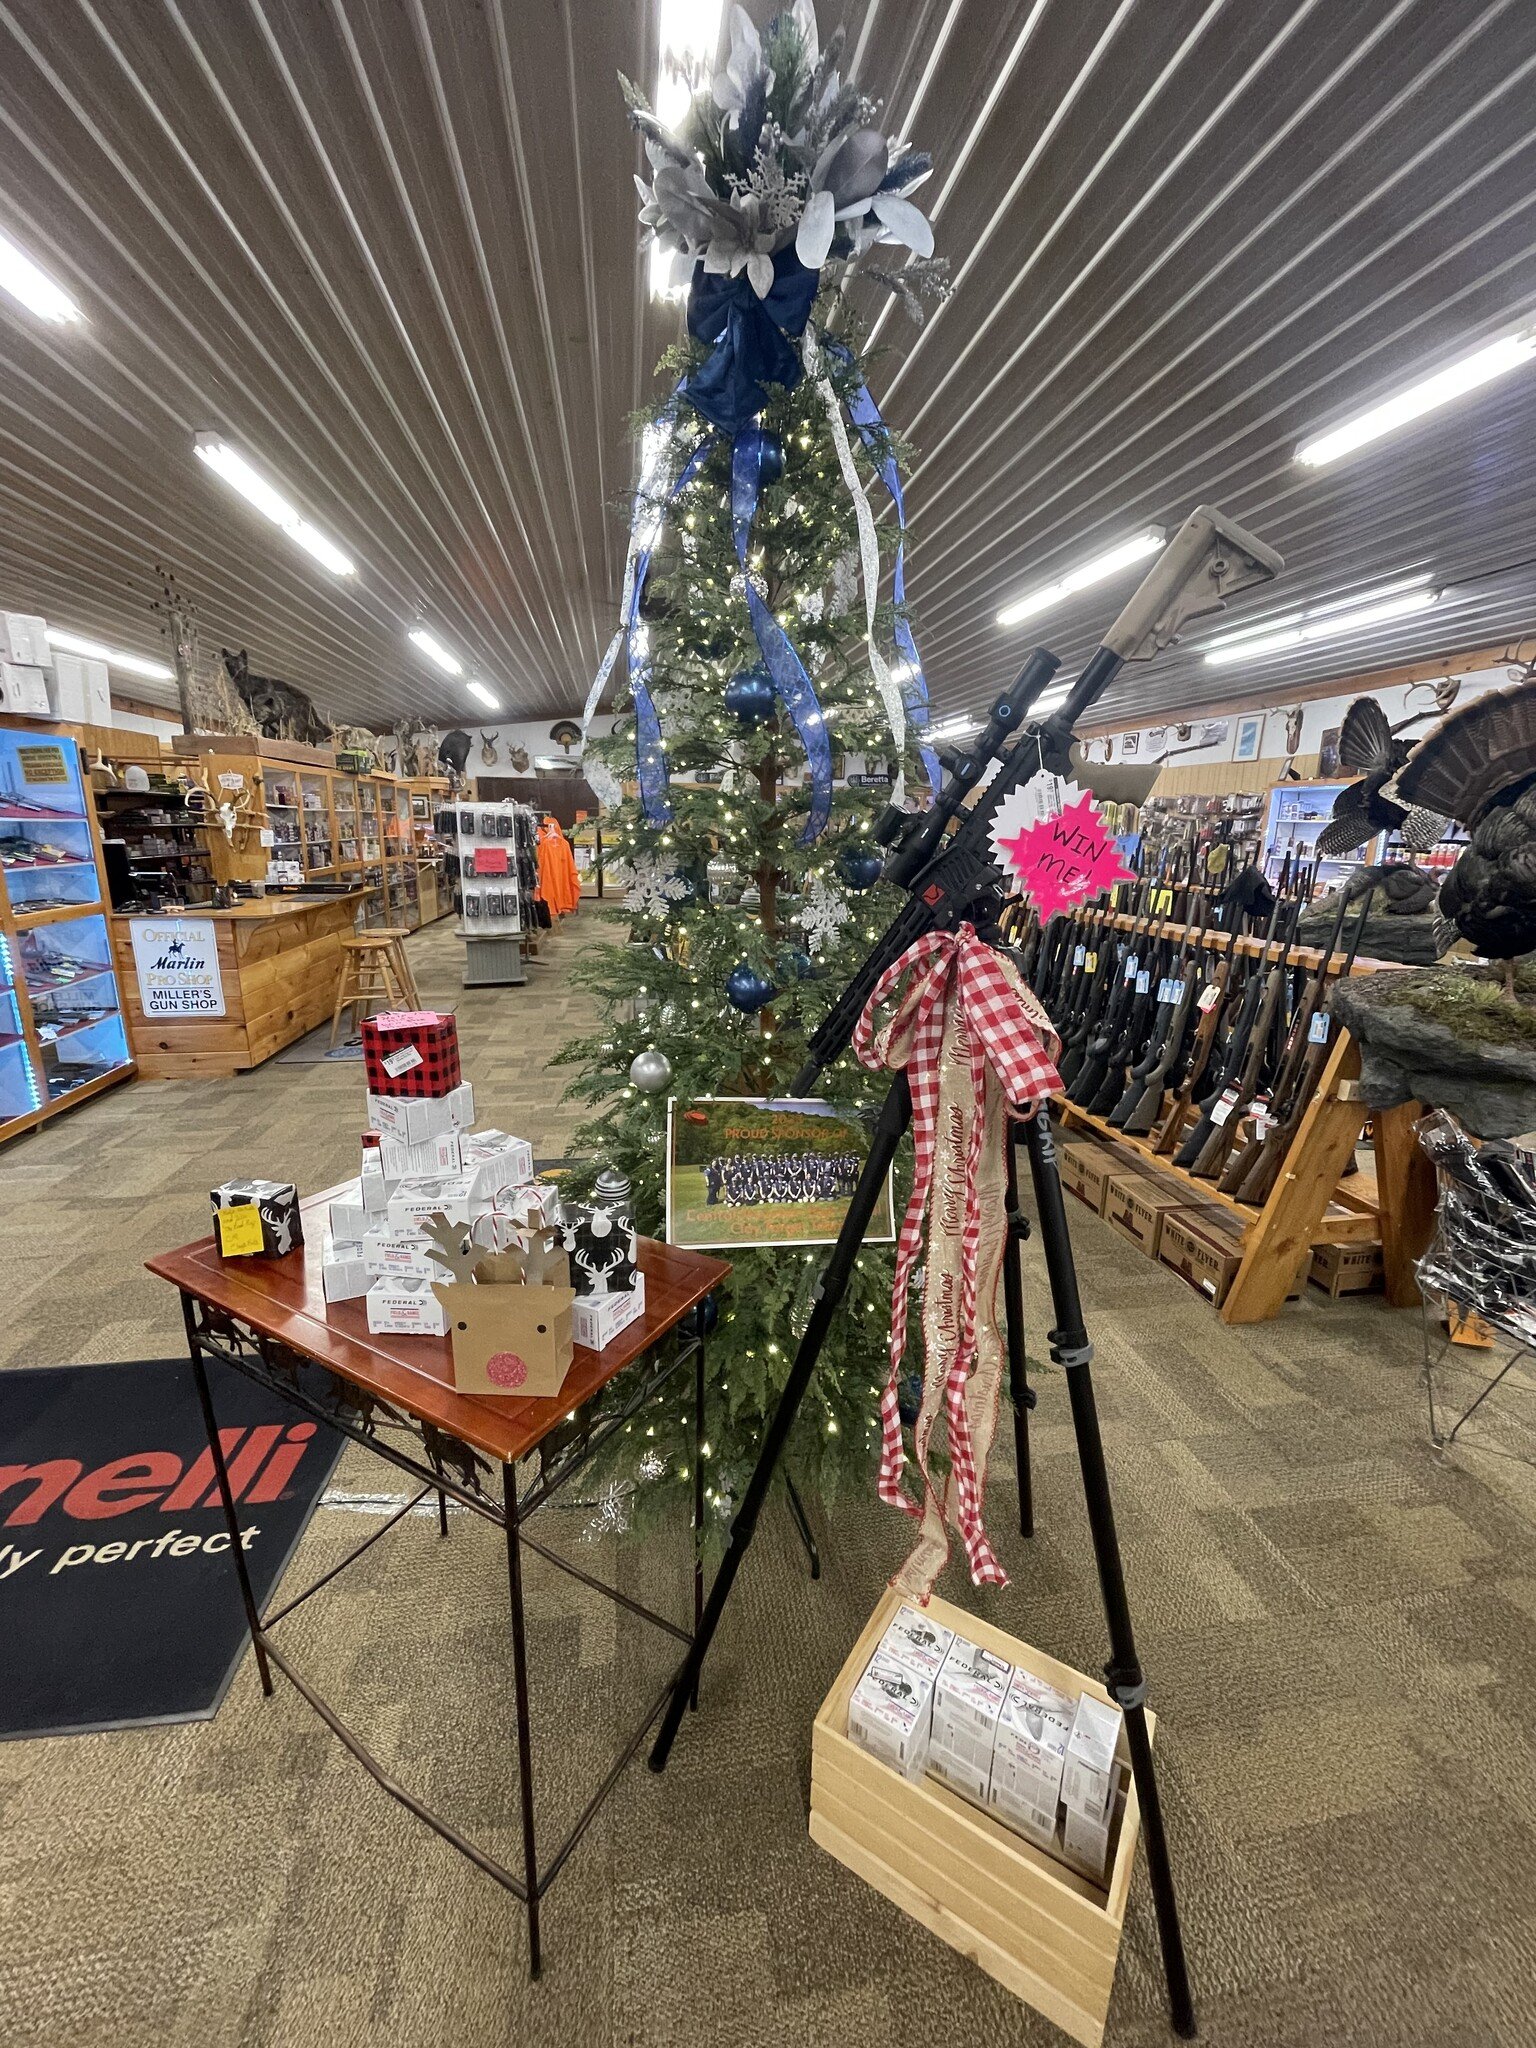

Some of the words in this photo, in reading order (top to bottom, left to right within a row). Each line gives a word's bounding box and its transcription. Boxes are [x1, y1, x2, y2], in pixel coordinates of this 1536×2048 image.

[861, 775, 889, 783] Beretta
[1053, 822, 1108, 863] WIN
[143, 928, 206, 942] OFFICIAL
[150, 956, 205, 970] Marlin
[146, 972, 177, 986] PRO
[178, 972, 213, 986] SHOP
[152, 989, 212, 1000] MILLER'S
[149, 1000, 178, 1010] GUN
[181, 999, 218, 1010] SHOP
[725, 1127, 769, 1139] PROUD
[771, 1127, 829, 1140] SPONSOR
[1085, 1168, 1100, 1186] FLYER
[939, 1182, 966, 1237] Merry
[1135, 1203, 1153, 1223] FLYER
[376, 1242, 409, 1250] FEDERAL
[1165, 1224, 1185, 1246] WHITE
[1197, 1248, 1220, 1272] FLYER
[1343, 1254, 1372, 1266] WHITE
[935, 1268, 957, 1342] Christmas
[49, 1525, 261, 1575] perfect
[892, 1622, 933, 1648] FEDERAL
[948, 1655, 992, 1684] FEDERAL
[866, 1671, 909, 1700] FDERAL
[1020, 1701, 1069, 1732] FEDERAL
